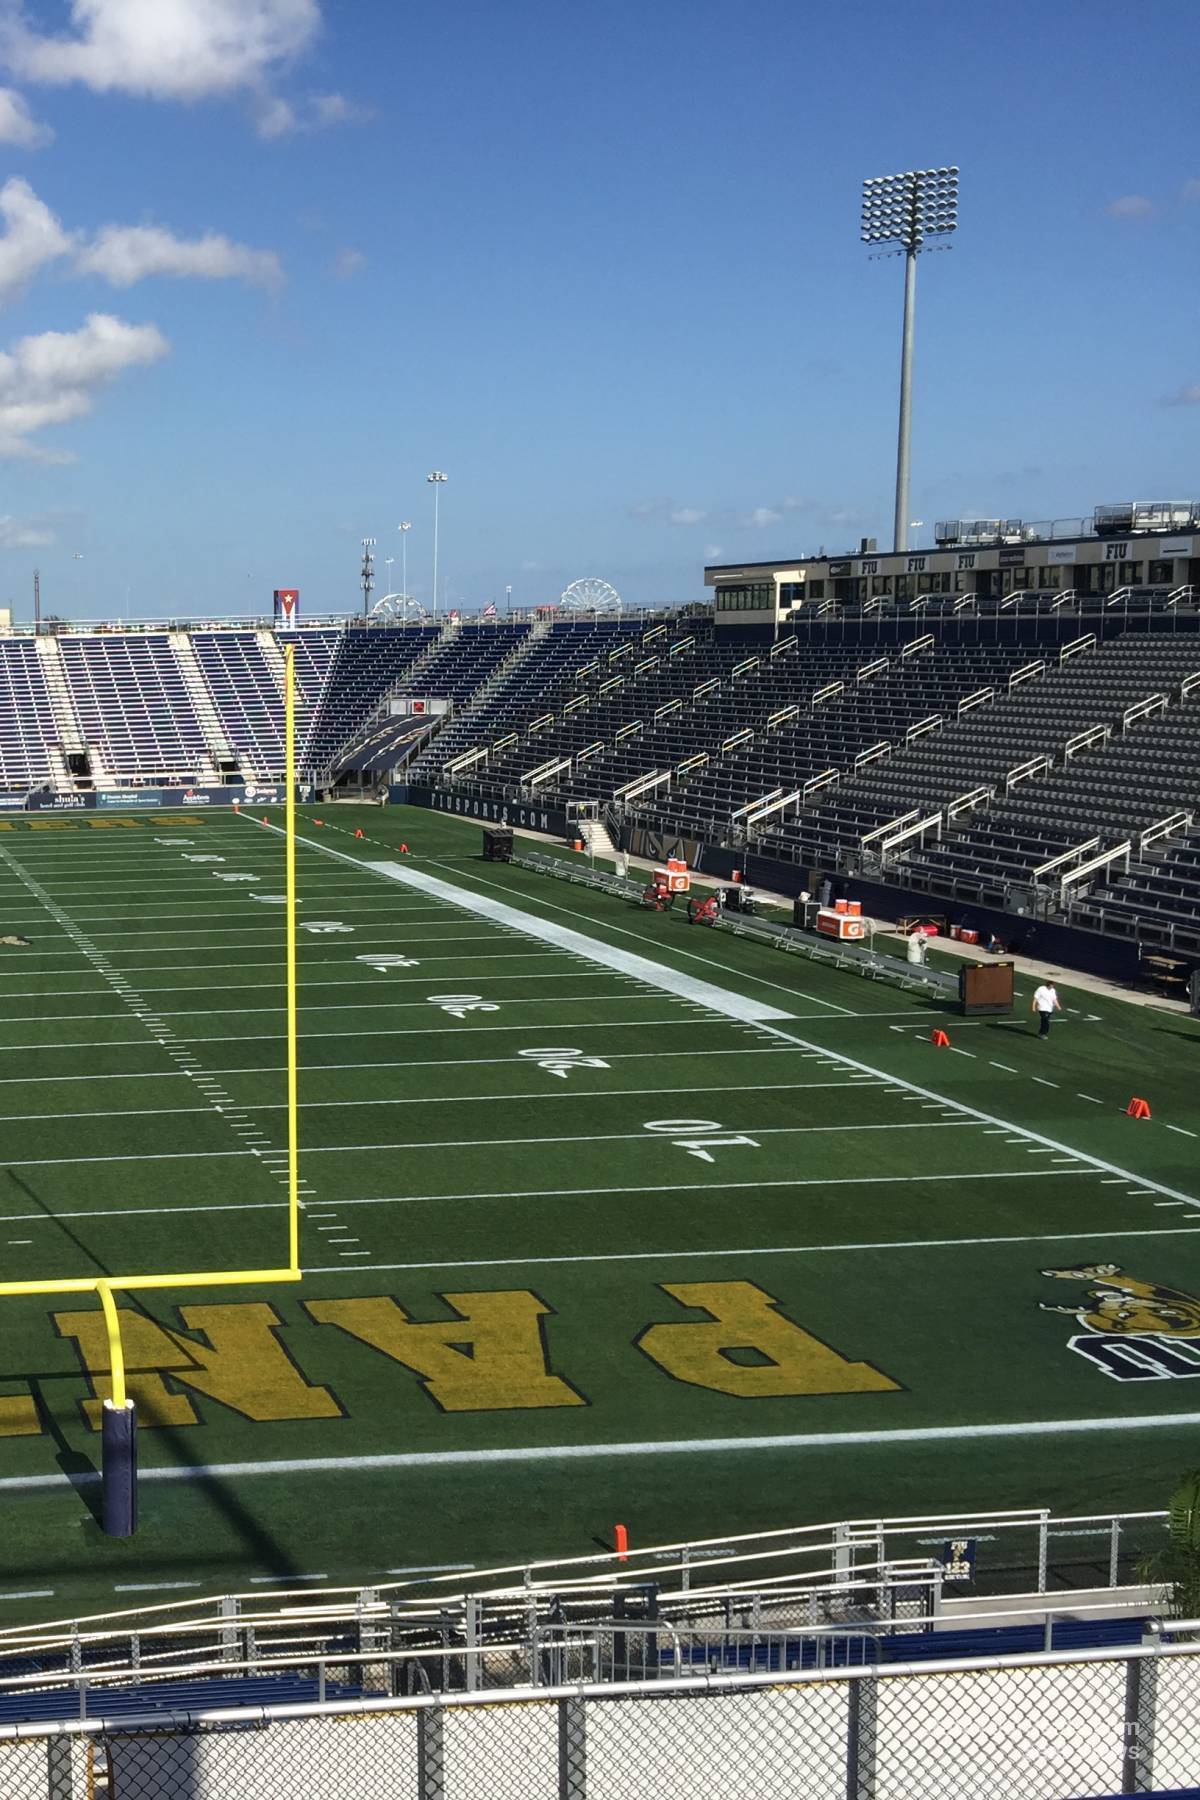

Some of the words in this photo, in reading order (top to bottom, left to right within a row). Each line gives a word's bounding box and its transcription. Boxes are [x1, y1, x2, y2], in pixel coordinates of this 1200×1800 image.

[1105, 543, 1127, 560] FIU
[861, 561, 877, 574] FIU
[908, 558, 926, 571] FIU
[958, 554, 976, 568] FIU
[431, 793, 548, 829] FIUSPORTS.COM
[675, 877, 684, 889] G
[847, 923, 859, 936] G
[427, 994, 501, 1013] 30
[518, 1047, 611, 1070] 20
[643, 1119, 761, 1149] 10
